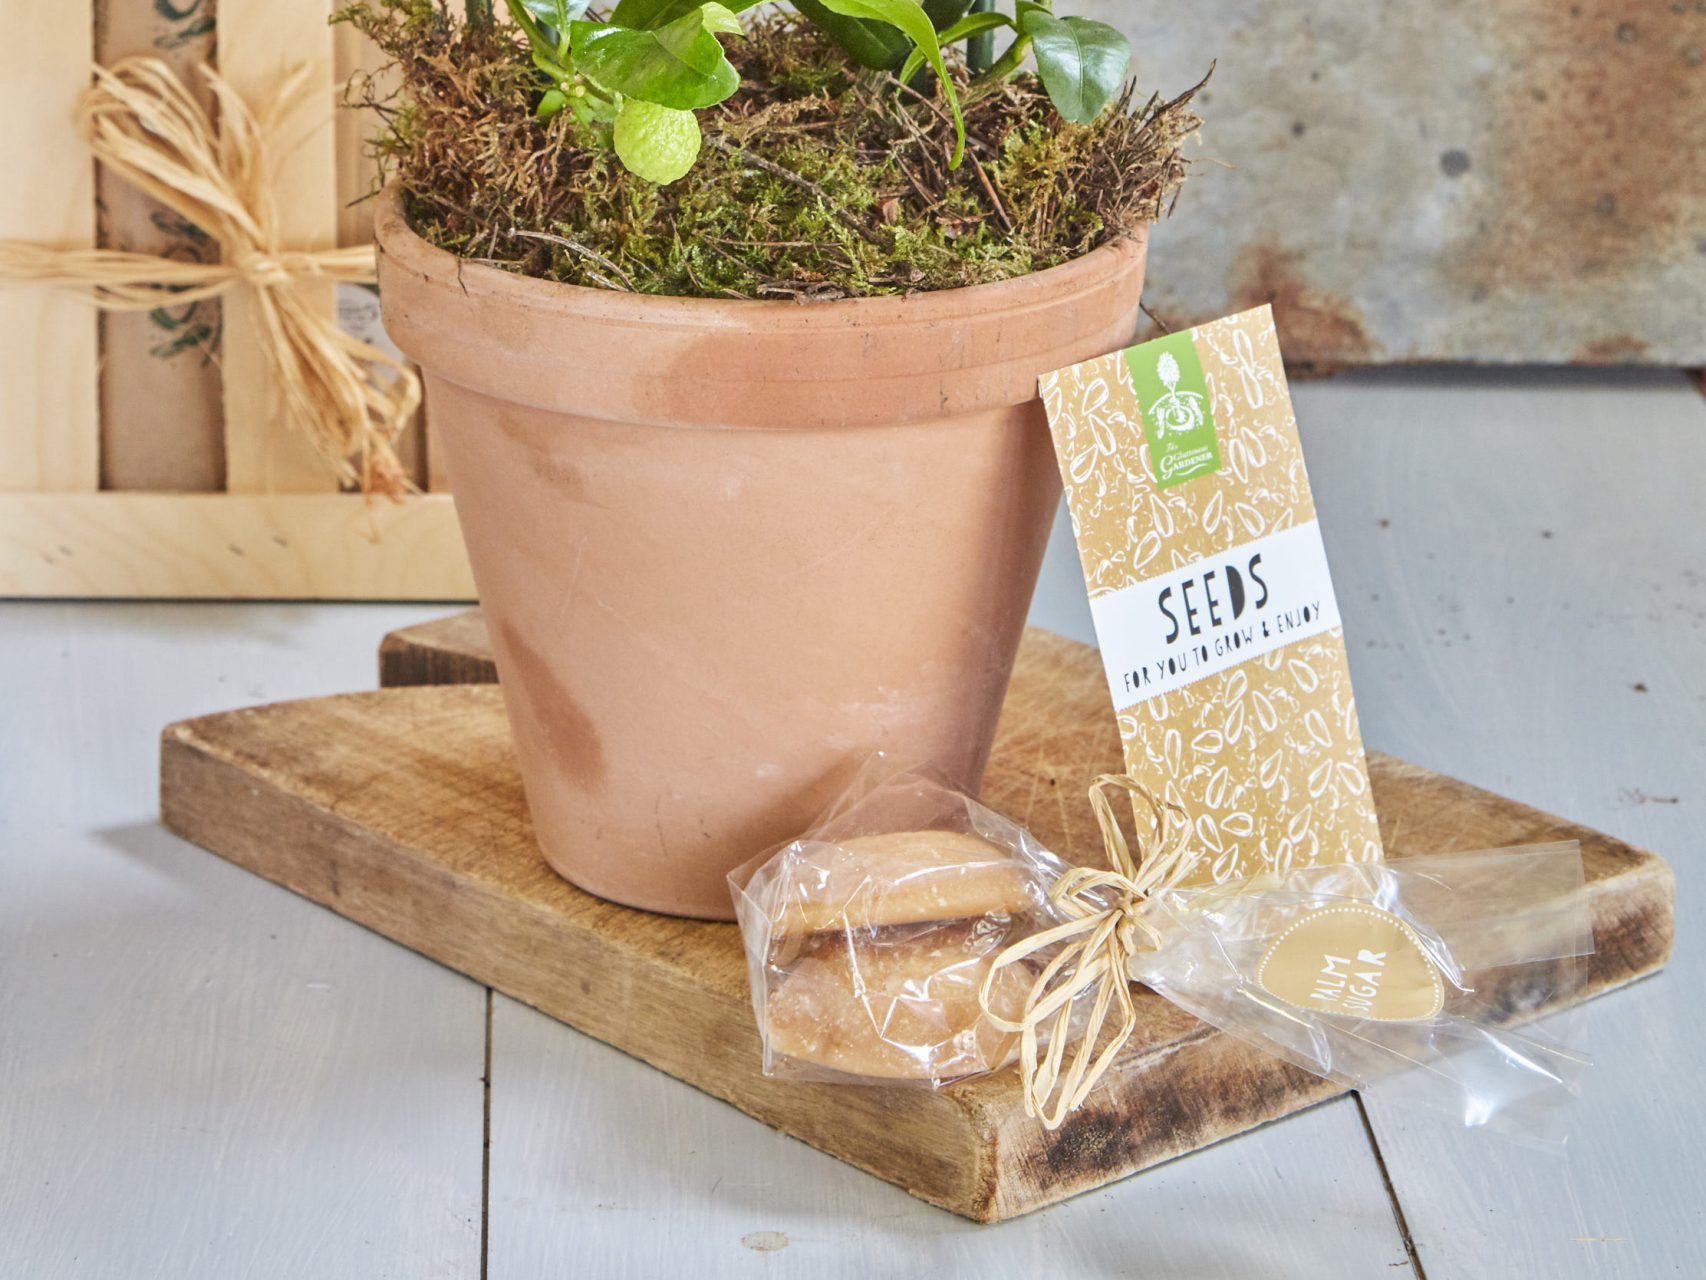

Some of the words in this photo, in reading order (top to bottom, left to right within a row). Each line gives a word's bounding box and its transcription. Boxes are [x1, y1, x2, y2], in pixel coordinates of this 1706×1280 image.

[1160, 452, 1213, 480] GARDENER
[1158, 553, 1268, 644] SEEDS
[1124, 667, 1151, 693] FOR
[1156, 654, 1187, 680] YOU
[1192, 644, 1208, 666] TO
[1215, 626, 1253, 657] GROW
[1262, 620, 1271, 638] &
[1276, 601, 1321, 634] ENJOY
[1310, 954, 1351, 1002] PALM
[1342, 949, 1387, 1012] SUGAR
